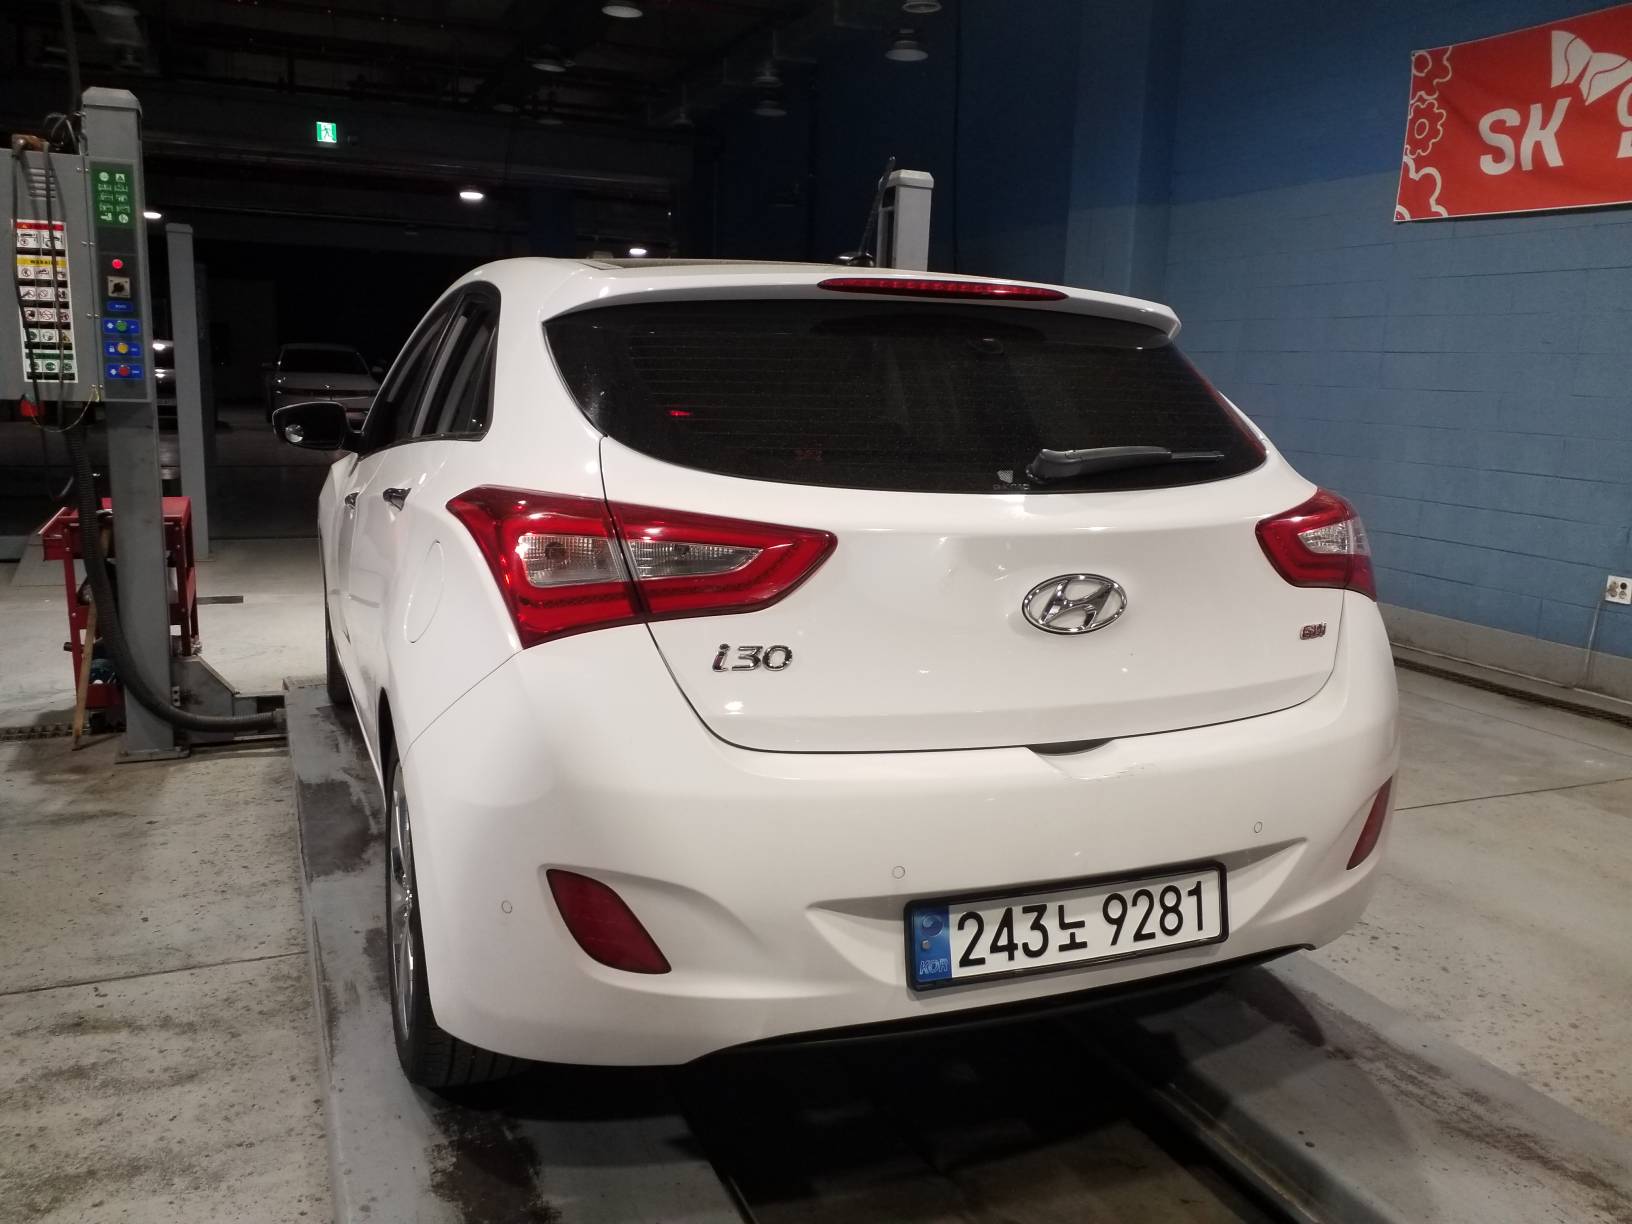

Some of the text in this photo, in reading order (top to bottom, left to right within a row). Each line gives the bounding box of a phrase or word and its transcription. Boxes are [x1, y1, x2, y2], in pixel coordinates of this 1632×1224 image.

[1478, 97, 1572, 175] SK
[712, 643, 793, 672] i30
[957, 881, 1203, 968] 243노 9281
[919, 958, 949, 975] KOR
